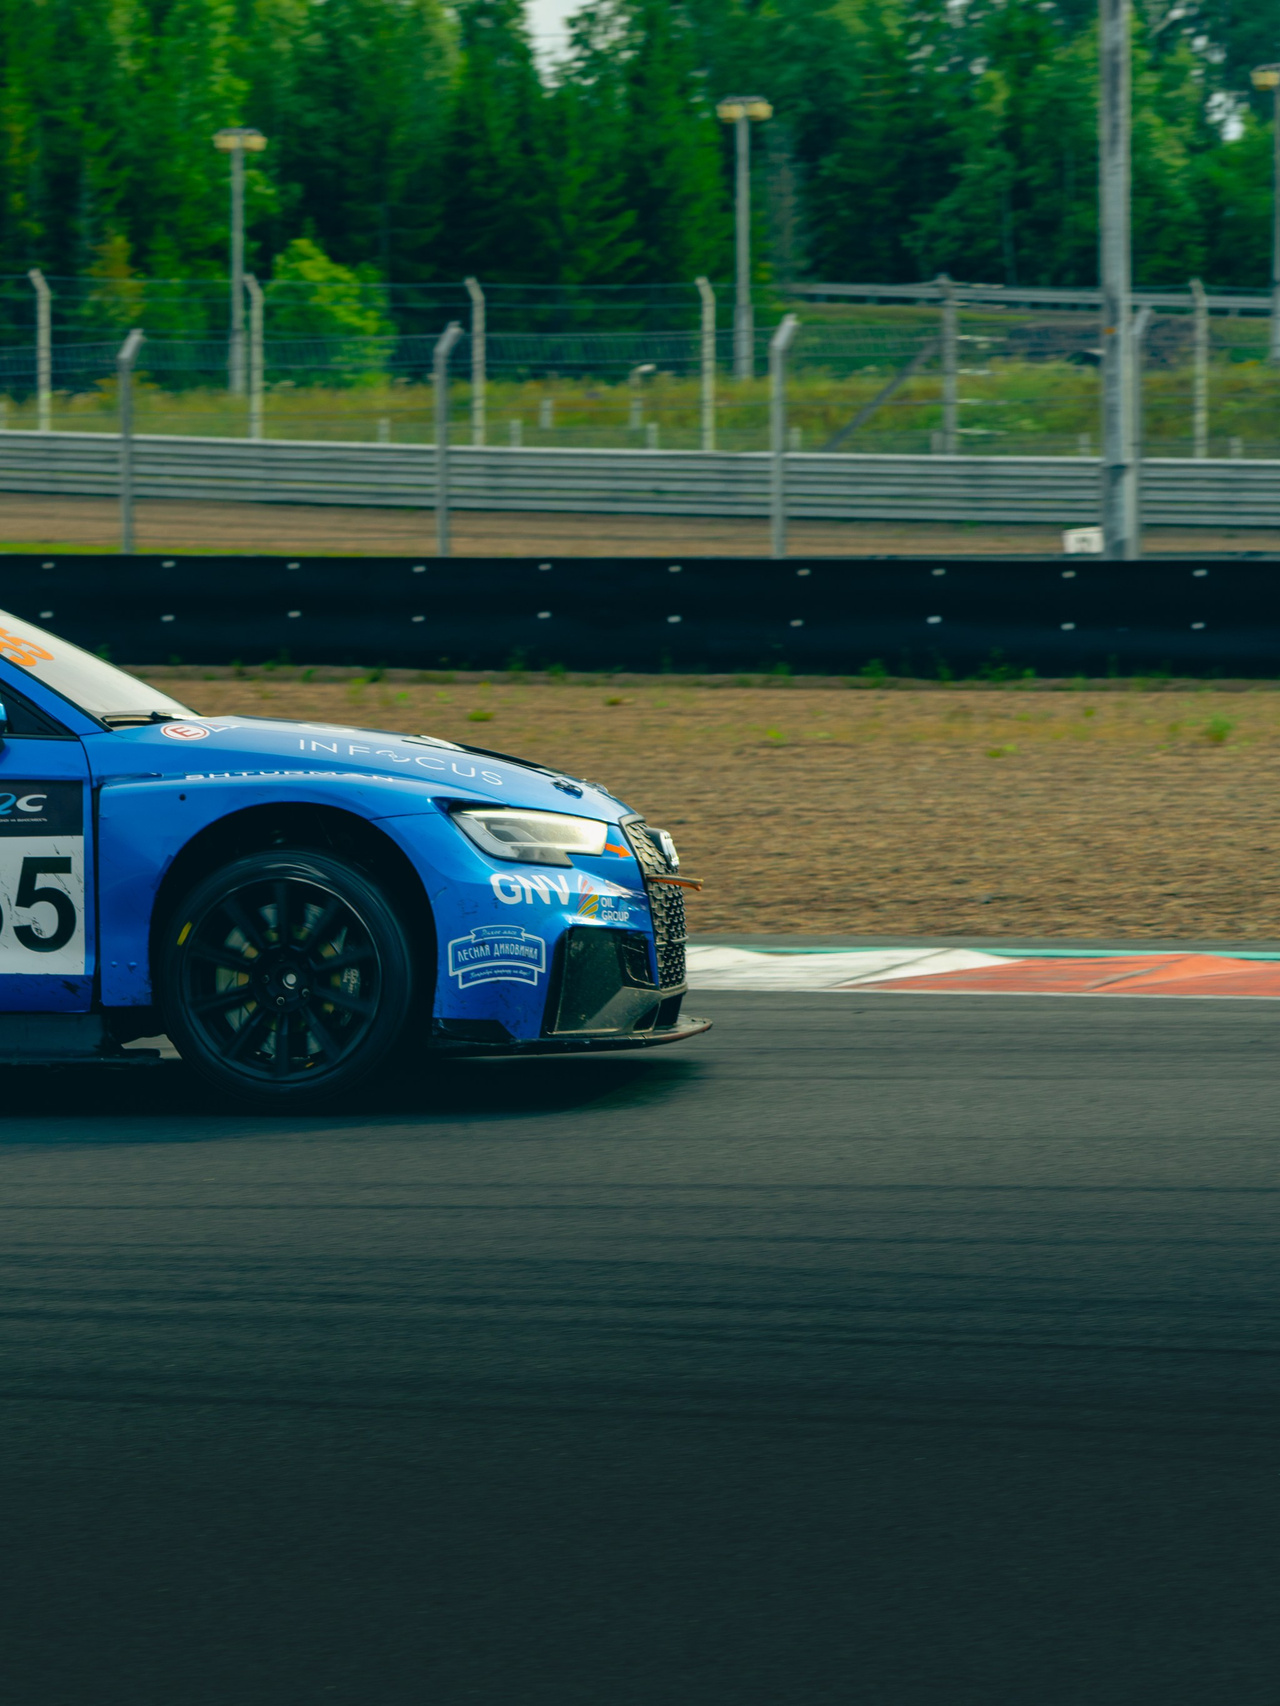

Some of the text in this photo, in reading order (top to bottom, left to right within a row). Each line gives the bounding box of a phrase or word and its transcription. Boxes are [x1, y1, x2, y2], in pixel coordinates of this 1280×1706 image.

[489, 873, 570, 906] GNV
[600, 897, 615, 908] OIL
[601, 909, 630, 922] GROUP
[457, 943, 538, 962] ЛЕСНАЯ ДИКОВИНКА
